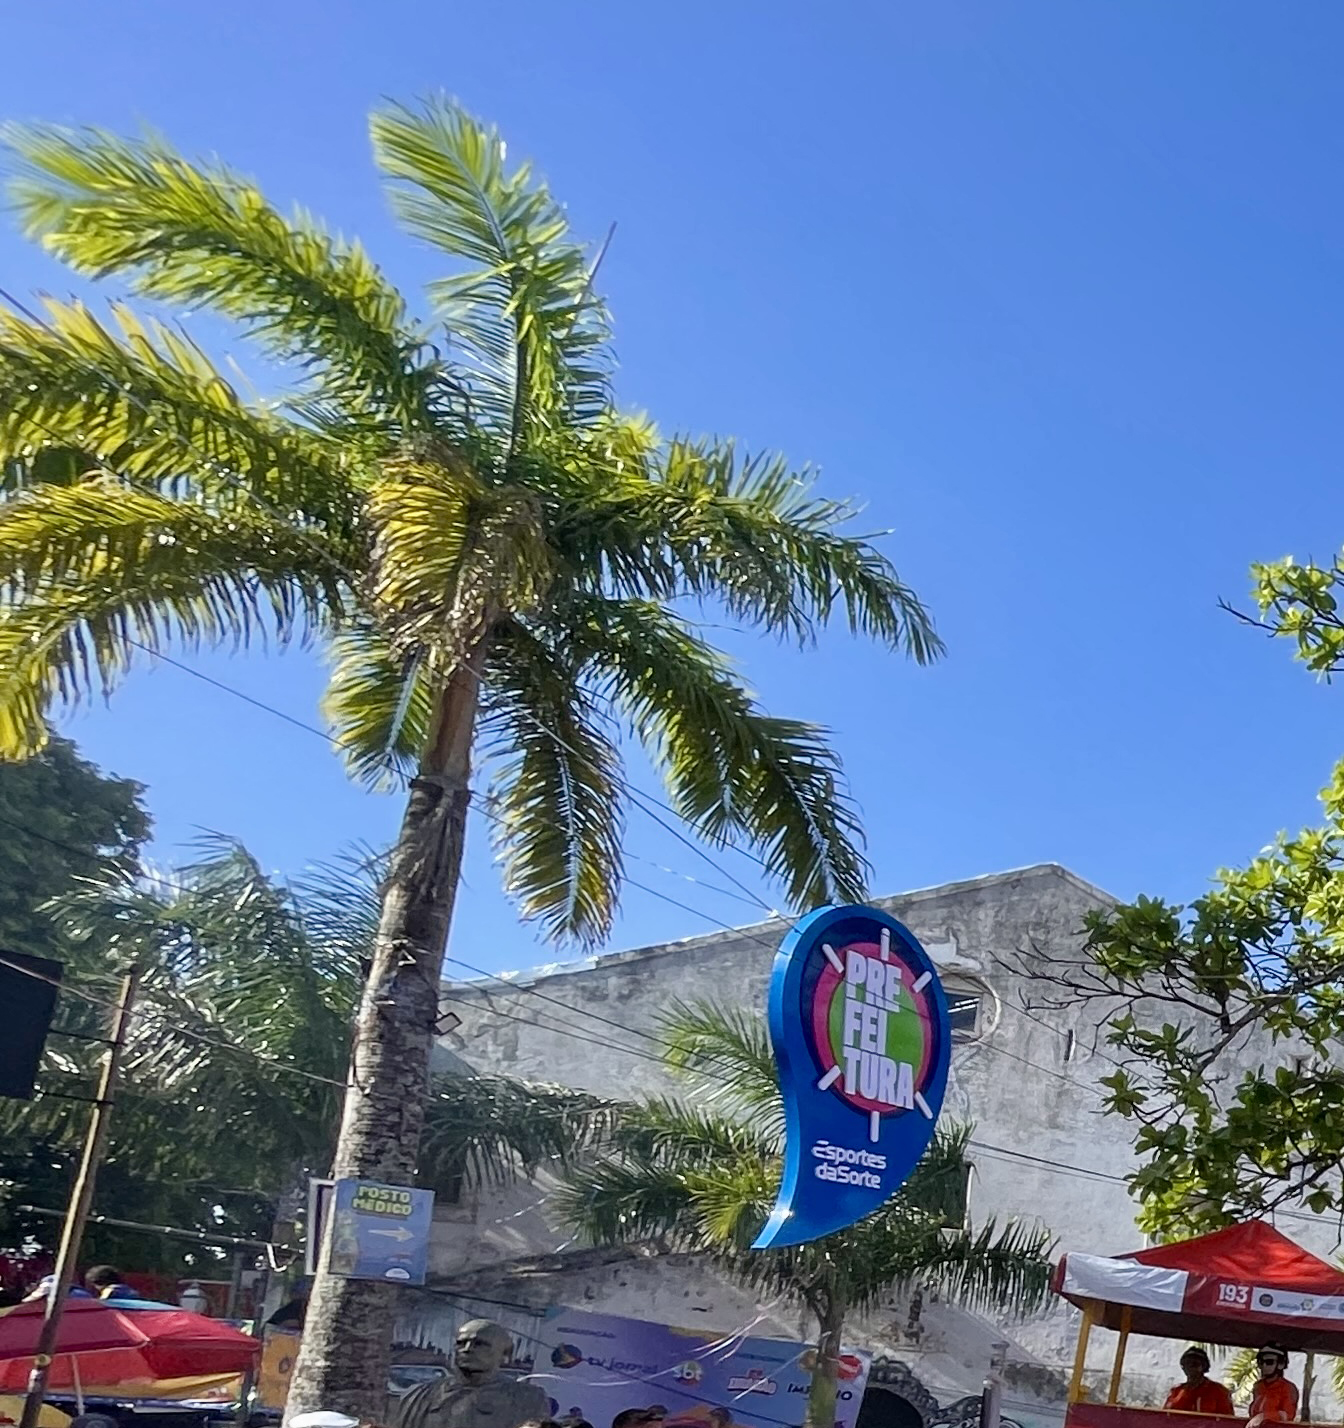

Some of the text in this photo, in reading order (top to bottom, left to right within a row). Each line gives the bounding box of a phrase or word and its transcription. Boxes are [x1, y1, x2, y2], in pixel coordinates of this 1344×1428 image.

[845, 950, 902, 1013] PRE
[844, 997, 888, 1056] FEI
[843, 1049, 914, 1110] TURA
[359, 1186, 411, 1203] POSTO
[1219, 1283, 1249, 1303] 193
